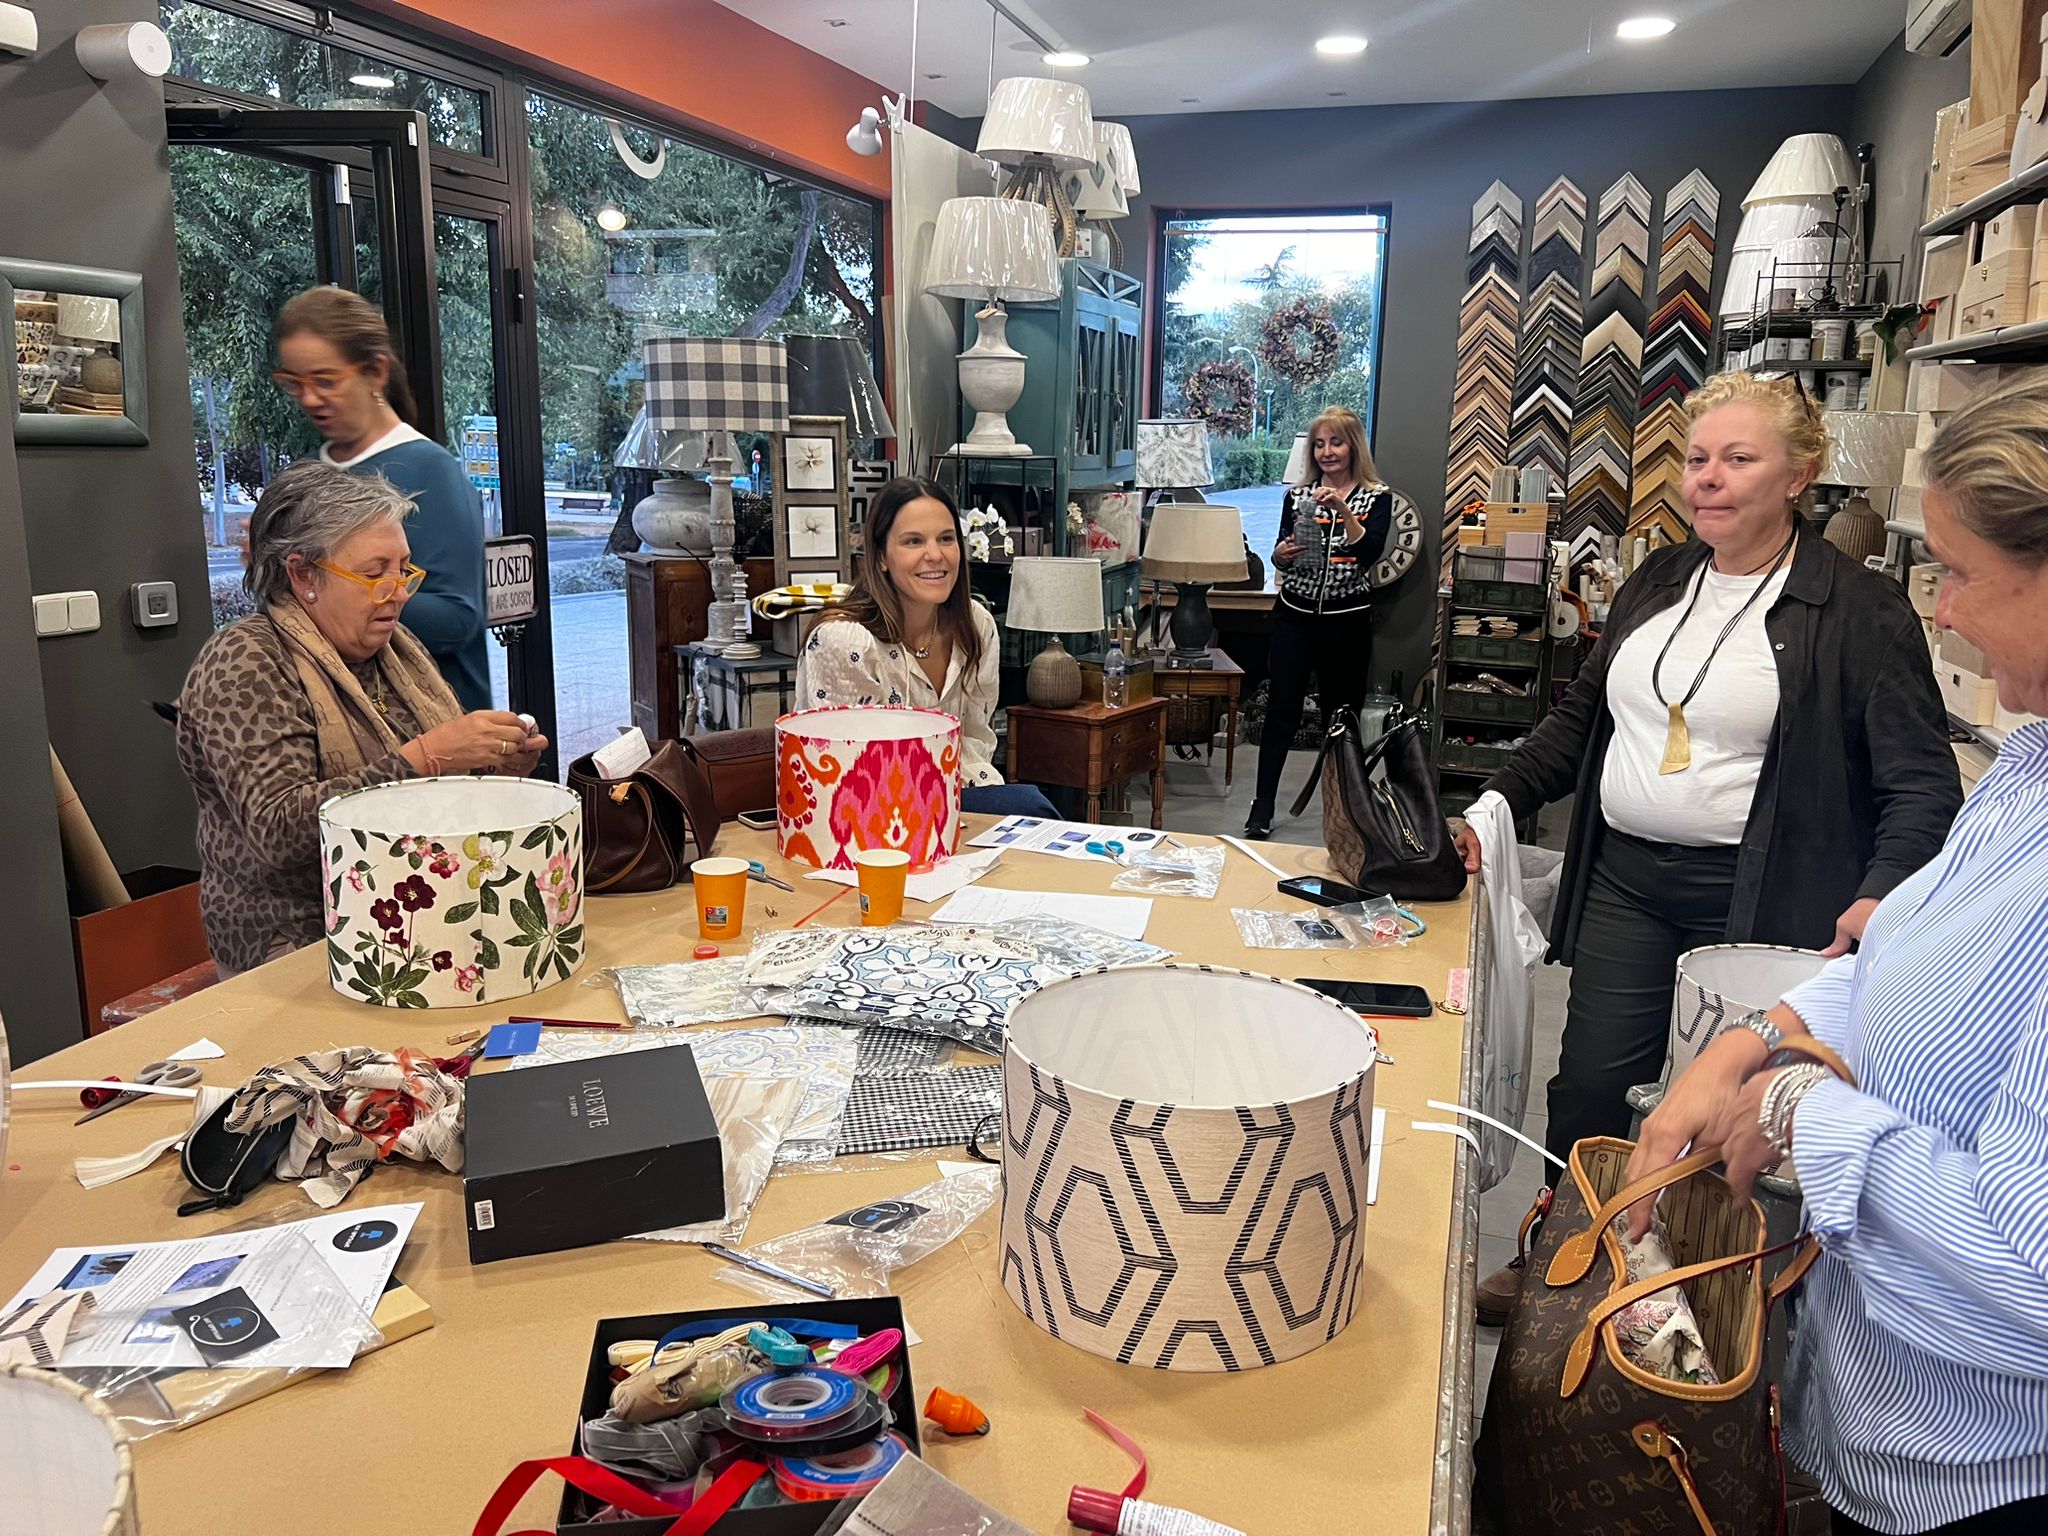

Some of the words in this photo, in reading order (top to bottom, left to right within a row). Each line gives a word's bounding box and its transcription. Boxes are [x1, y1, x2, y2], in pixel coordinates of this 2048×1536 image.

[1403, 513, 1413, 526] 2
[1404, 533, 1413, 546] 3
[1396, 552, 1405, 566] 4
[488, 555, 531, 588] LOSED
[510, 590, 532, 608] SORRY
[583, 1078, 609, 1128] LOEWE
